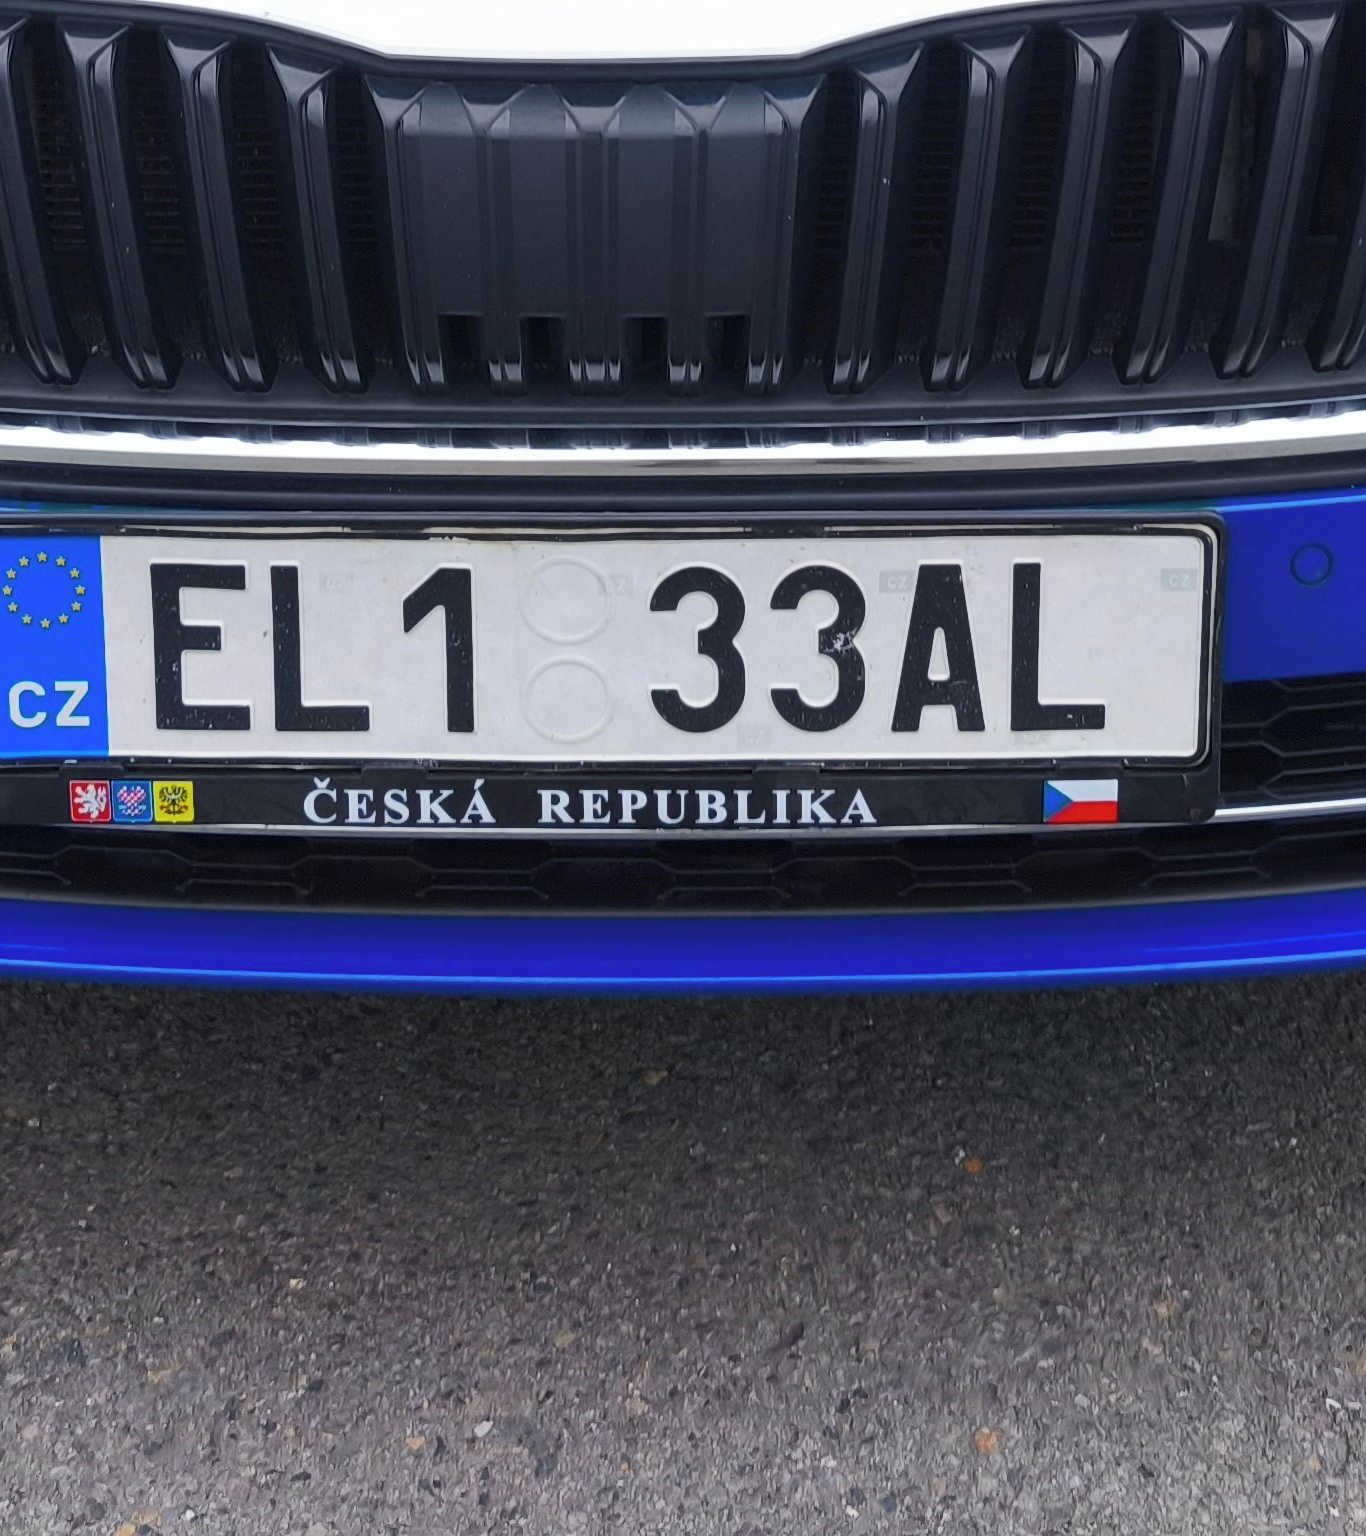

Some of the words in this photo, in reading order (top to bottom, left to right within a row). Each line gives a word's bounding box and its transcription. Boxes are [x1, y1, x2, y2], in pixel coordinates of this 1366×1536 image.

[149, 562, 476, 733] EL1
[648, 562, 1107, 734] 33AL
[8, 680, 91, 729] CZ
[303, 776, 497, 825] ČESKÁ
[537, 788, 877, 825] REPUBLIKA
